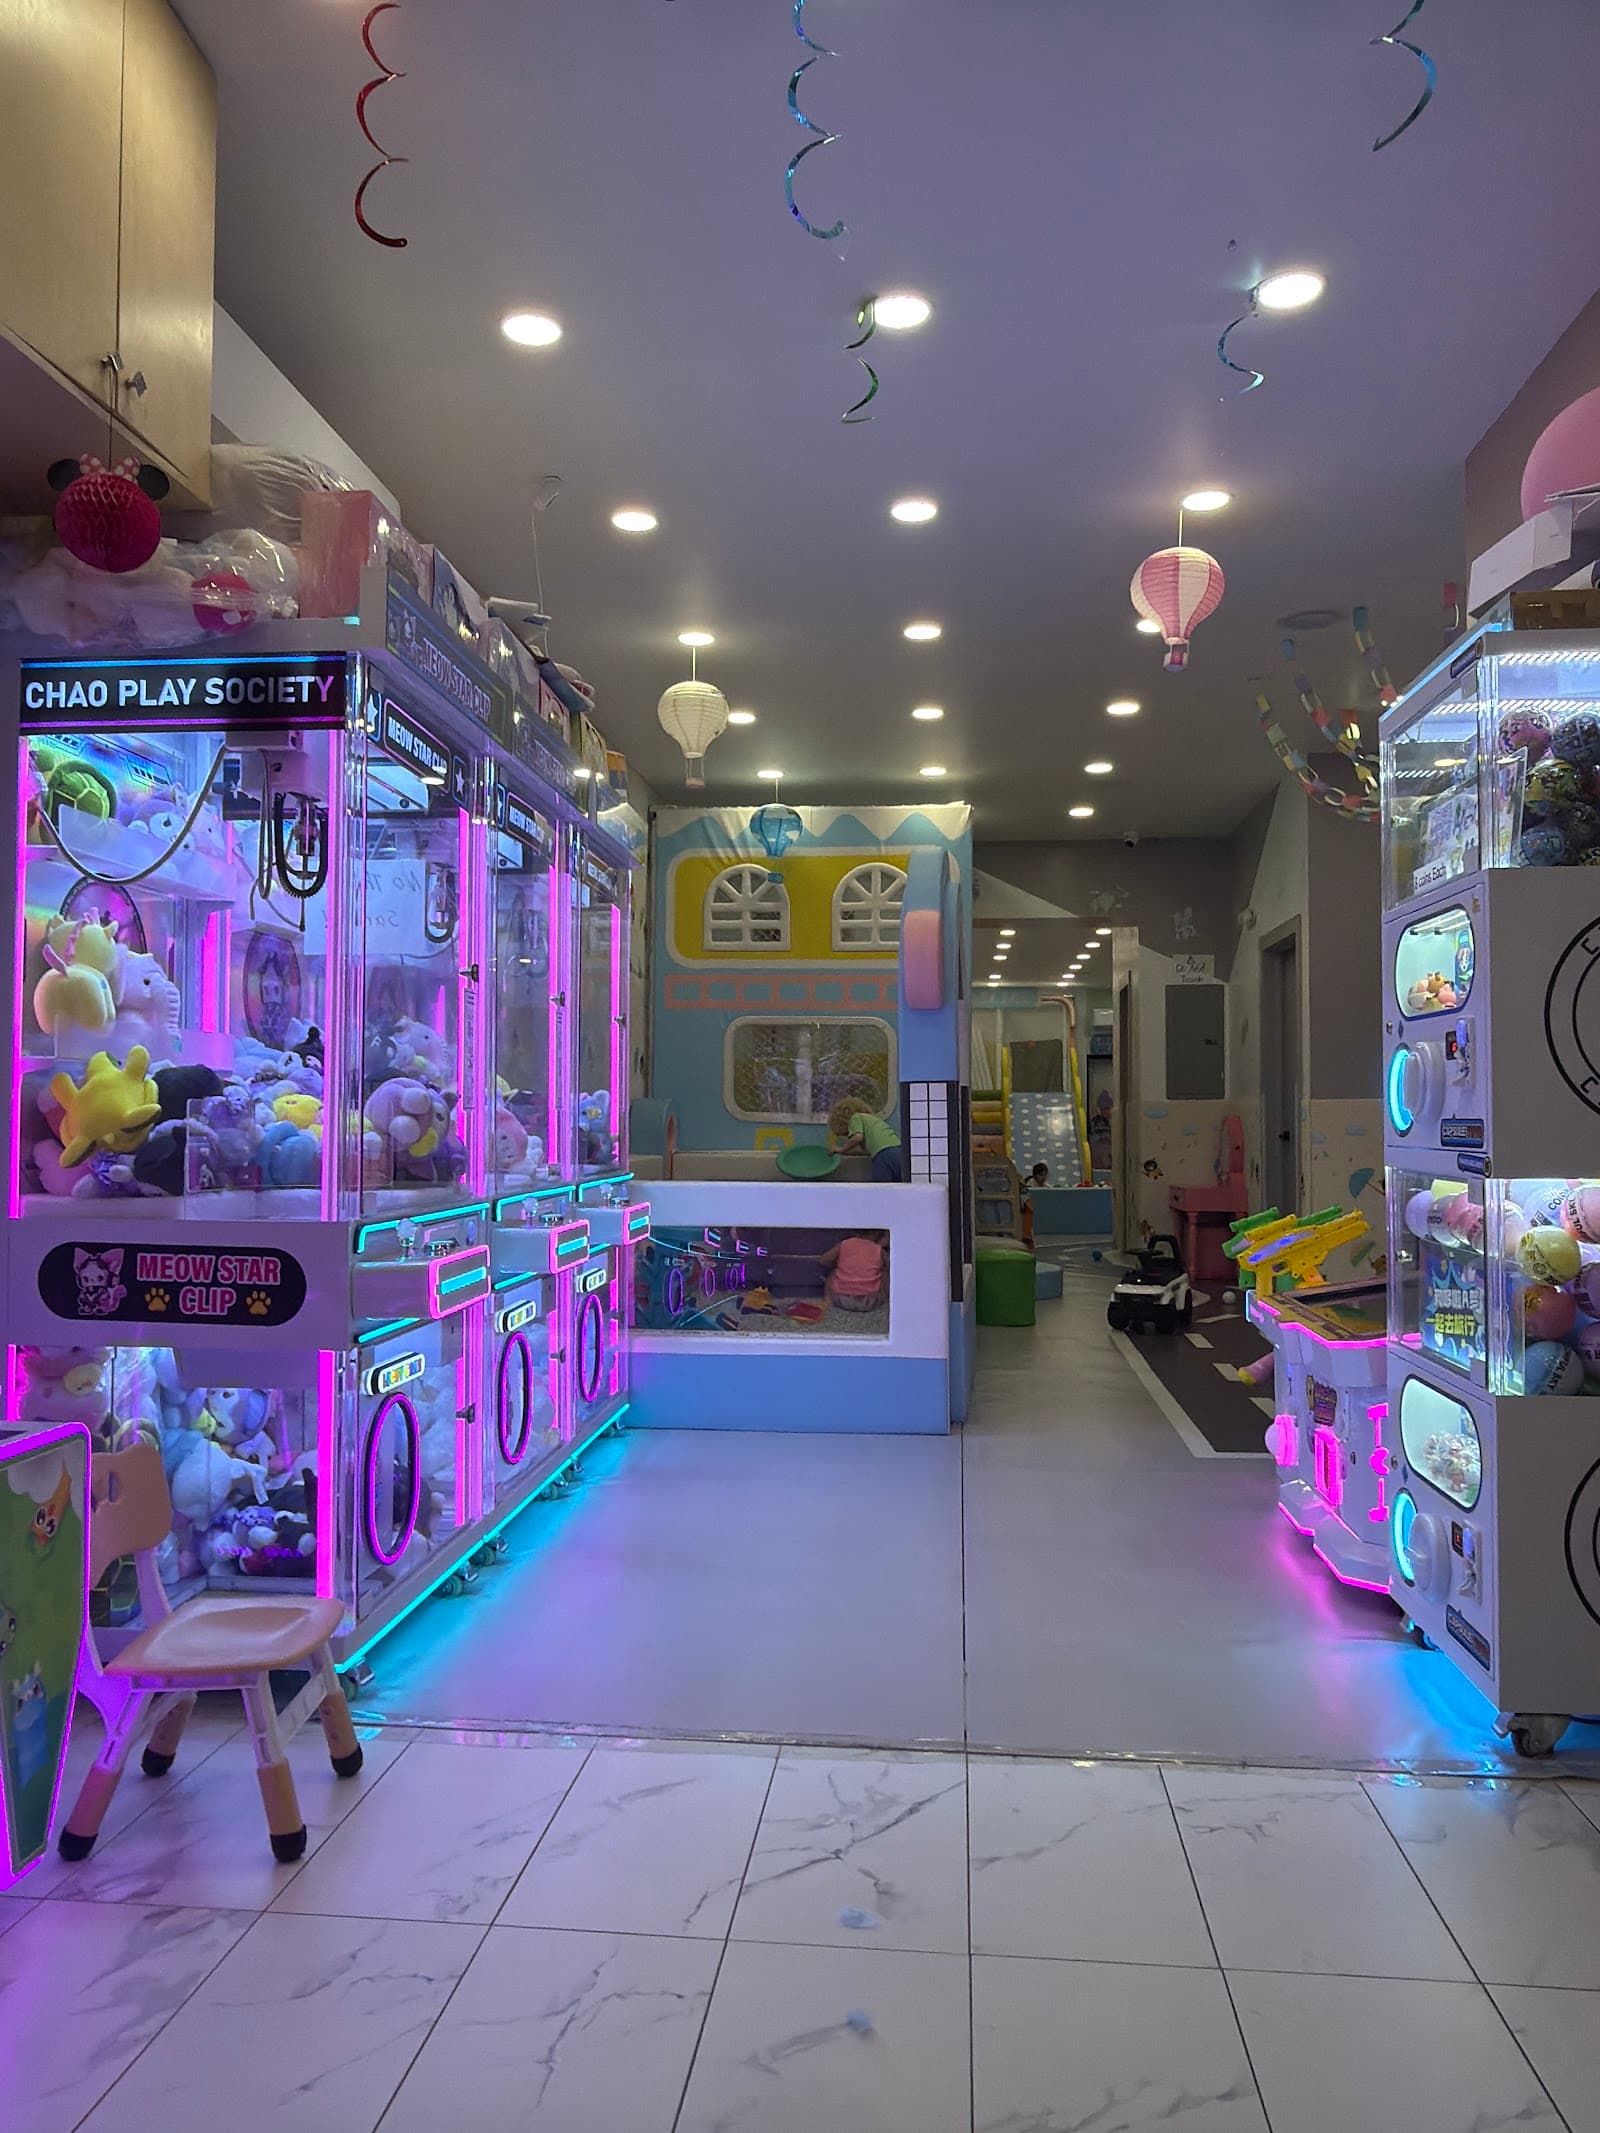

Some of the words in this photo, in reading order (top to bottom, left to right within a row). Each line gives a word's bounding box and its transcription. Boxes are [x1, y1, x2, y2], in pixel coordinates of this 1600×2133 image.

[25, 680, 109, 710] CHAO
[118, 677, 197, 708] PLAY
[203, 674, 334, 706] SOCIETY
[388, 716, 413, 753] MEOW
[413, 736, 432, 767] STAR
[136, 1253, 218, 1284] MEOW
[217, 1255, 281, 1286] STAR
[178, 1287, 237, 1316] CLIP
